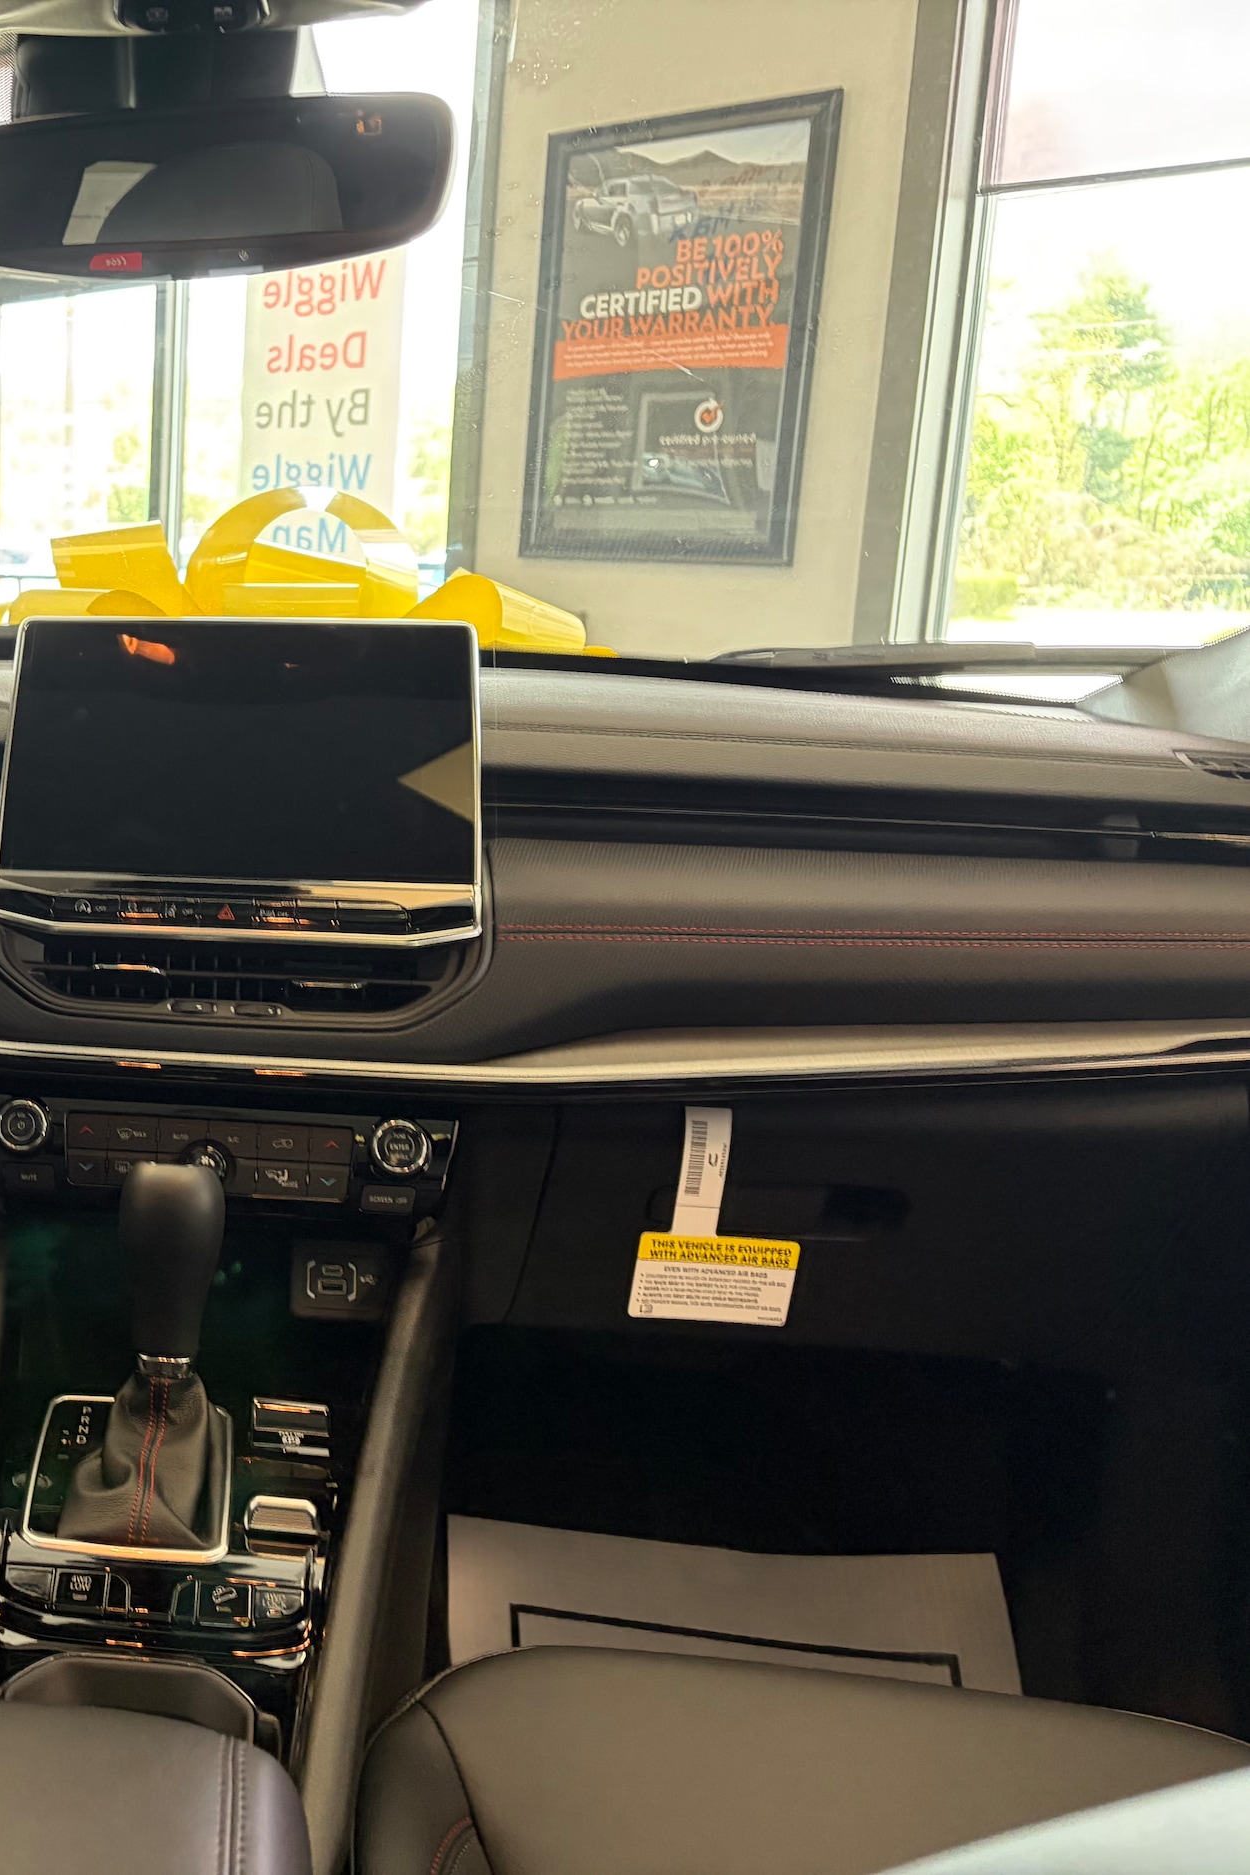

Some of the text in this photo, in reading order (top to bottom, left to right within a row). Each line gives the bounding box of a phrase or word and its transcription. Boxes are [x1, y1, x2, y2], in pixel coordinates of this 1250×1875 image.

[676, 229, 784, 263] BE 100%
[636, 252, 783, 289] POSITIVELY
[579, 279, 779, 319] CERTIFIED WITH
[561, 316, 626, 342] YOUR
[390, 1143, 410, 1151] ENTER
[369, 1195, 393, 1204] SCREEN
[651, 1238, 792, 1258] THIS VEHICLE IS EQUIPPED
[650, 1249, 790, 1268] WITH ADVANCED AIR BAGS
[701, 1268, 736, 1276] ADVANCED
[81, 1415, 90, 1424] R
[78, 1425, 89, 1434] N
[71, 1575, 92, 1583] 4WD
[70, 1582, 91, 1591] LOW
